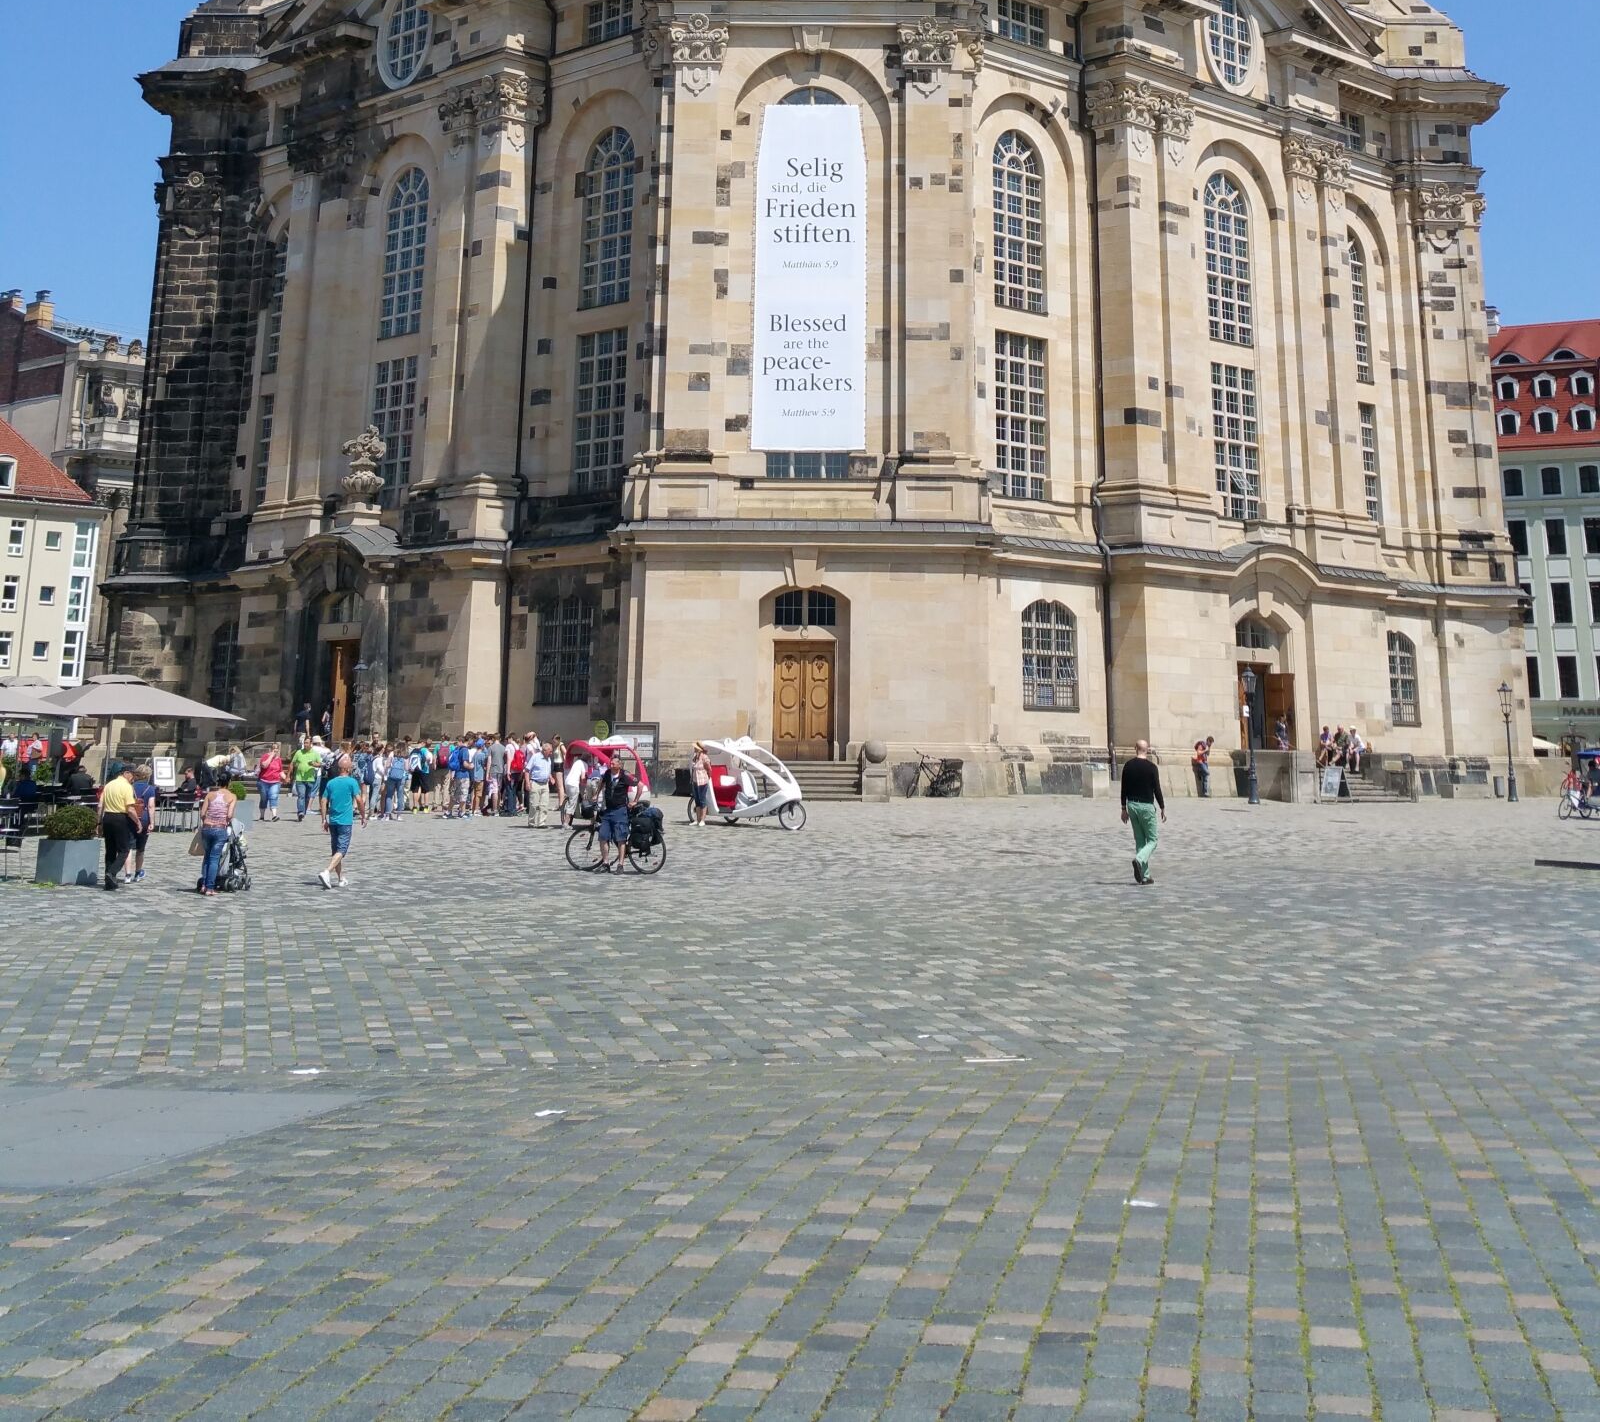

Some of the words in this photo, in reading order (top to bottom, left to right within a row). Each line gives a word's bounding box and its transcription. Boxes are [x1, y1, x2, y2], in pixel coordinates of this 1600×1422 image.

[786, 157, 844, 183] Selig
[771, 182, 803, 195] sind,
[807, 182, 827, 193] die
[765, 197, 857, 218] Frieden
[773, 222, 856, 243] stiften.
[782, 260, 822, 269] Matthäus
[824, 260, 839, 269] 5,9
[769, 314, 847, 332] Blessed
[783, 340, 803, 349] are
[808, 338, 830, 349] the
[762, 356, 831, 375] peace-
[775, 373, 856, 392] makers.
[781, 408, 819, 417] Matthew
[342, 624, 349, 635] D
[1251, 649, 1257, 660] B
